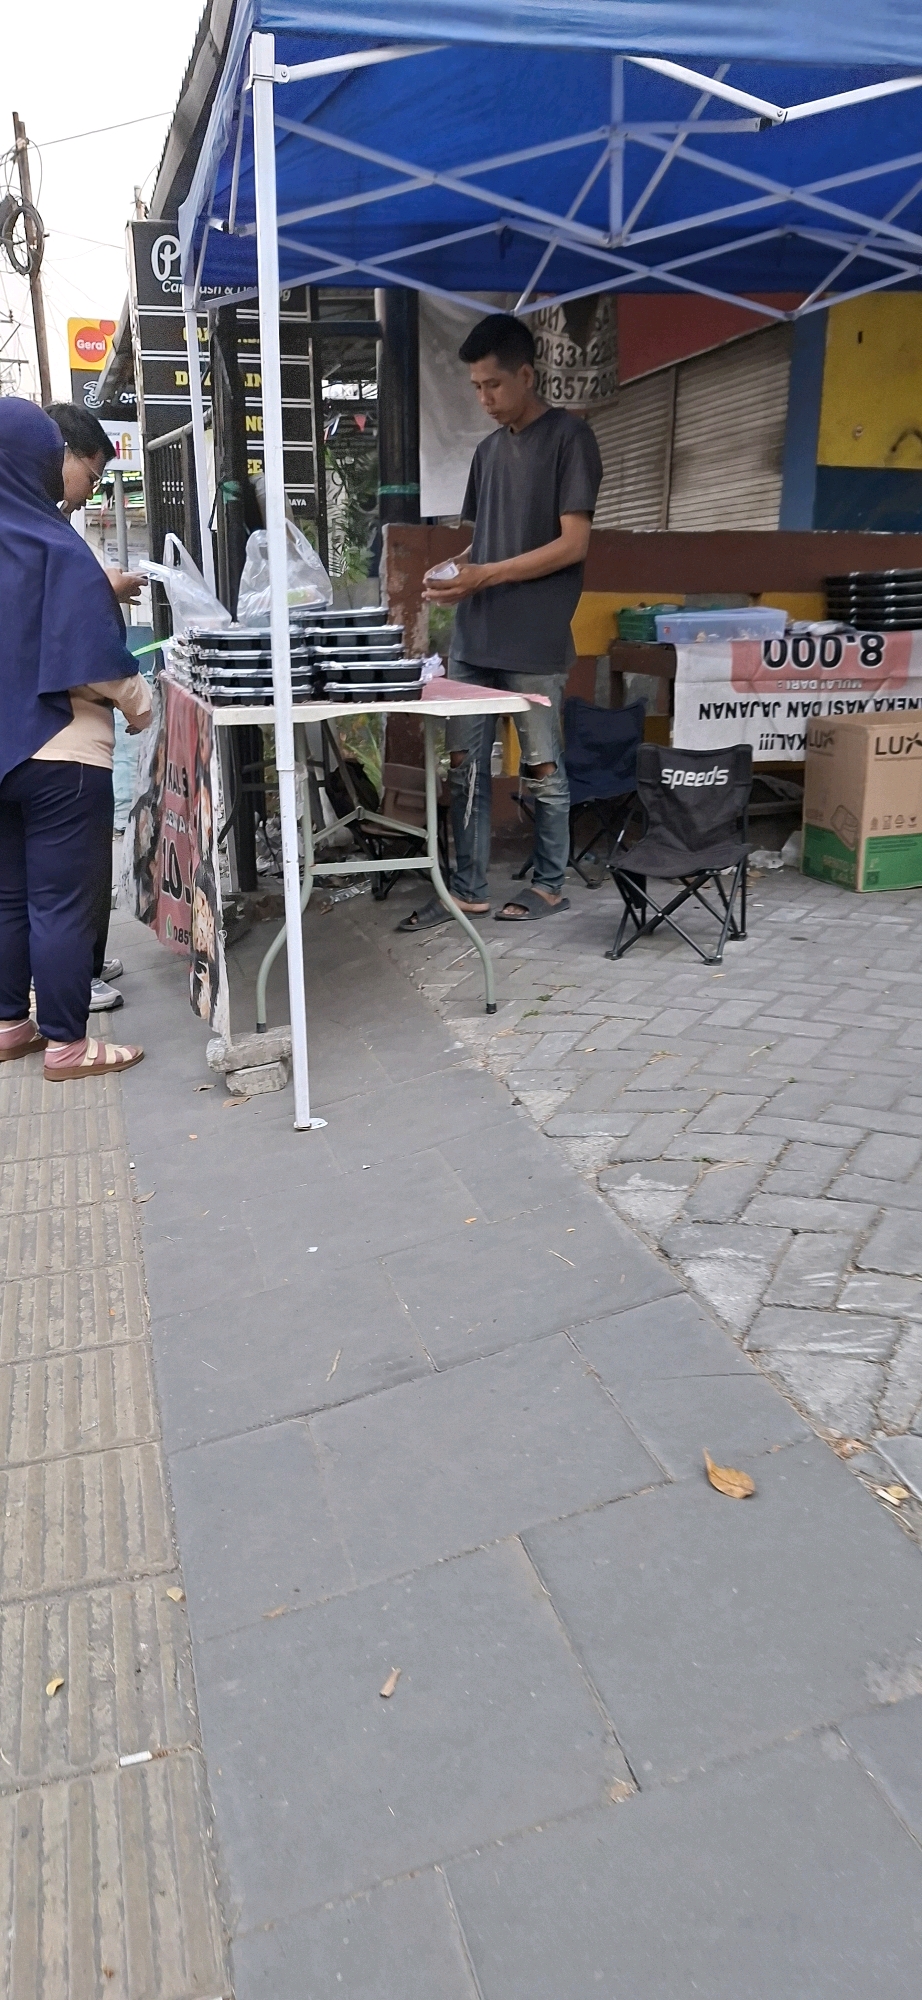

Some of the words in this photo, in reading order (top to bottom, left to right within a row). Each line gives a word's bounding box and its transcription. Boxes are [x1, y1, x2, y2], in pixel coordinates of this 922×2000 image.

[76, 339, 106, 351] Gerai
[763, 634, 886, 669] 8.000
[785, 679, 818, 690] DARI
[698, 701, 781, 720] JAJANAN
[786, 701, 822, 718] DAN
[873, 697, 922, 712] NEKA
[758, 733, 808, 751] KAL!!!
[661, 765, 729, 790] speeds
